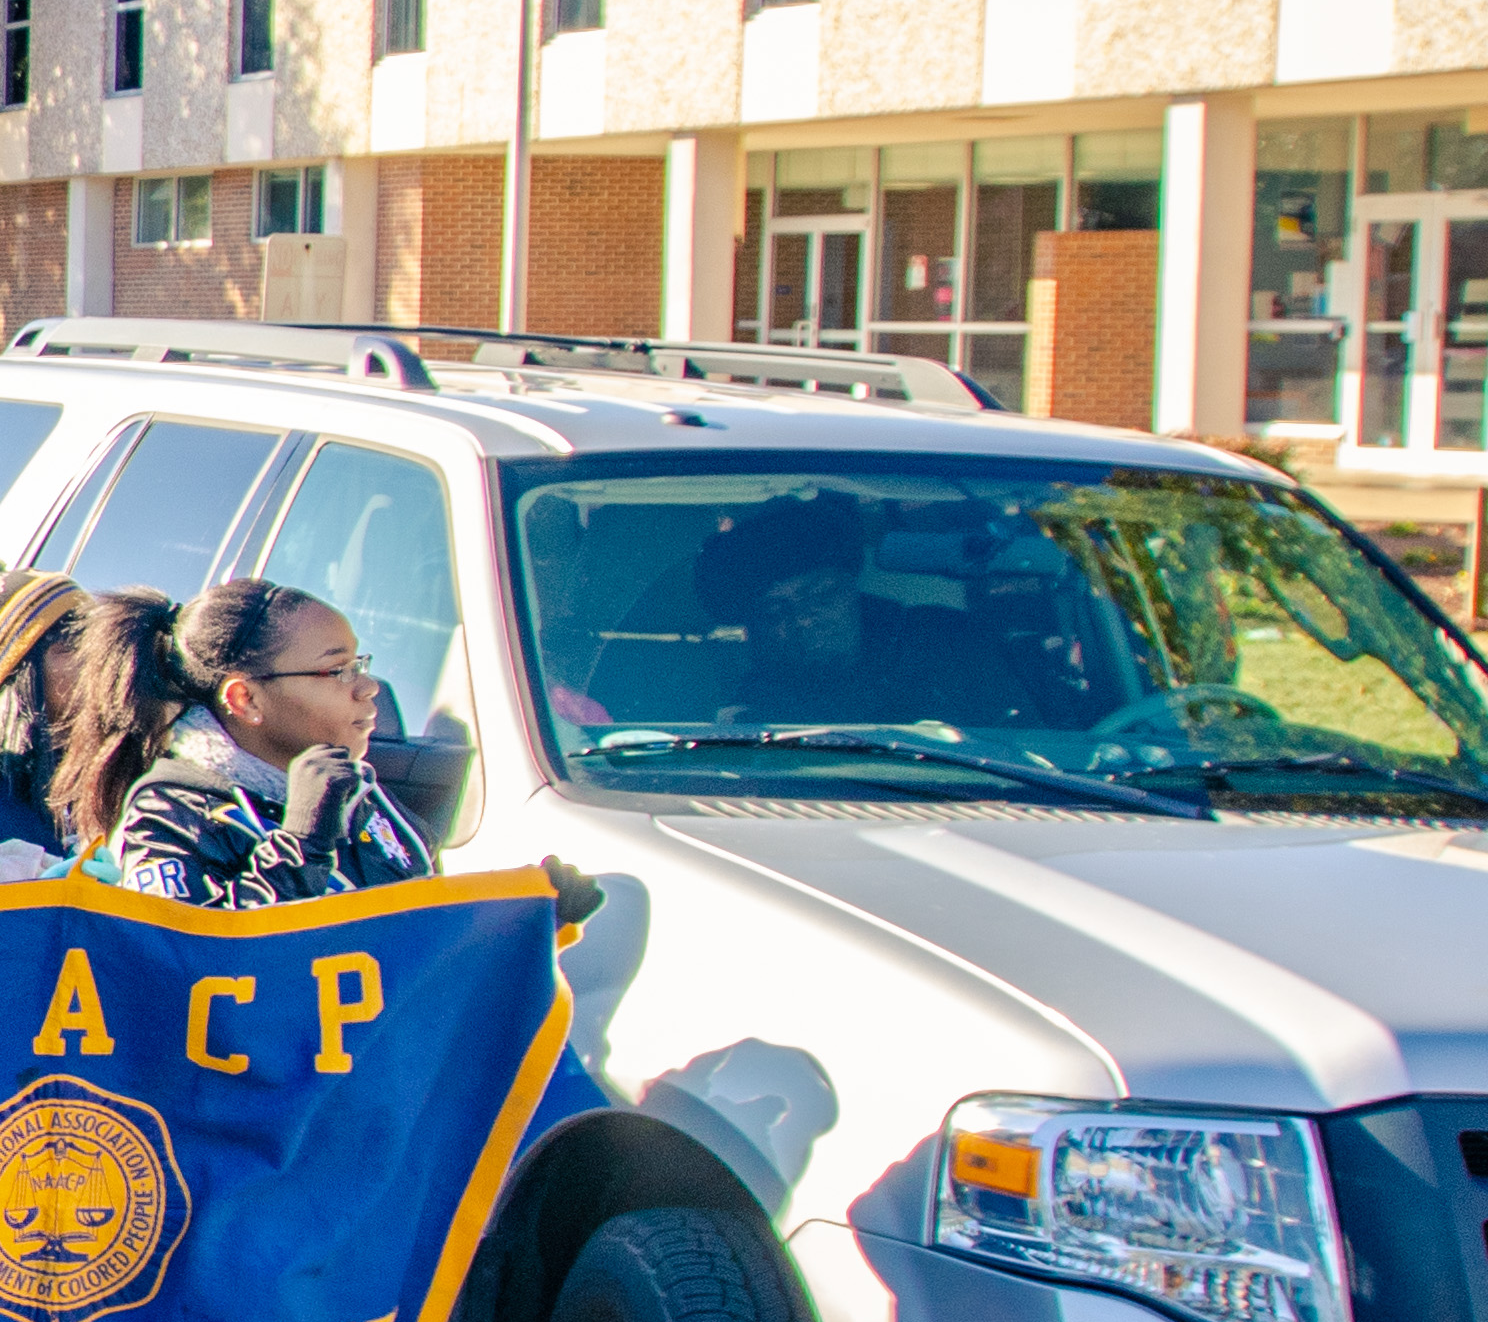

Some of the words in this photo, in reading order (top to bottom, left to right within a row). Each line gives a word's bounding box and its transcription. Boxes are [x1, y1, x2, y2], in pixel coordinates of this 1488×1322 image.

[50, 1110, 149, 1182] ASSOCIATION
[38, 1279, 52, 1297] of
[58, 1250, 131, 1299] COLORED
[122, 1188, 154, 1252] PEOPLE
